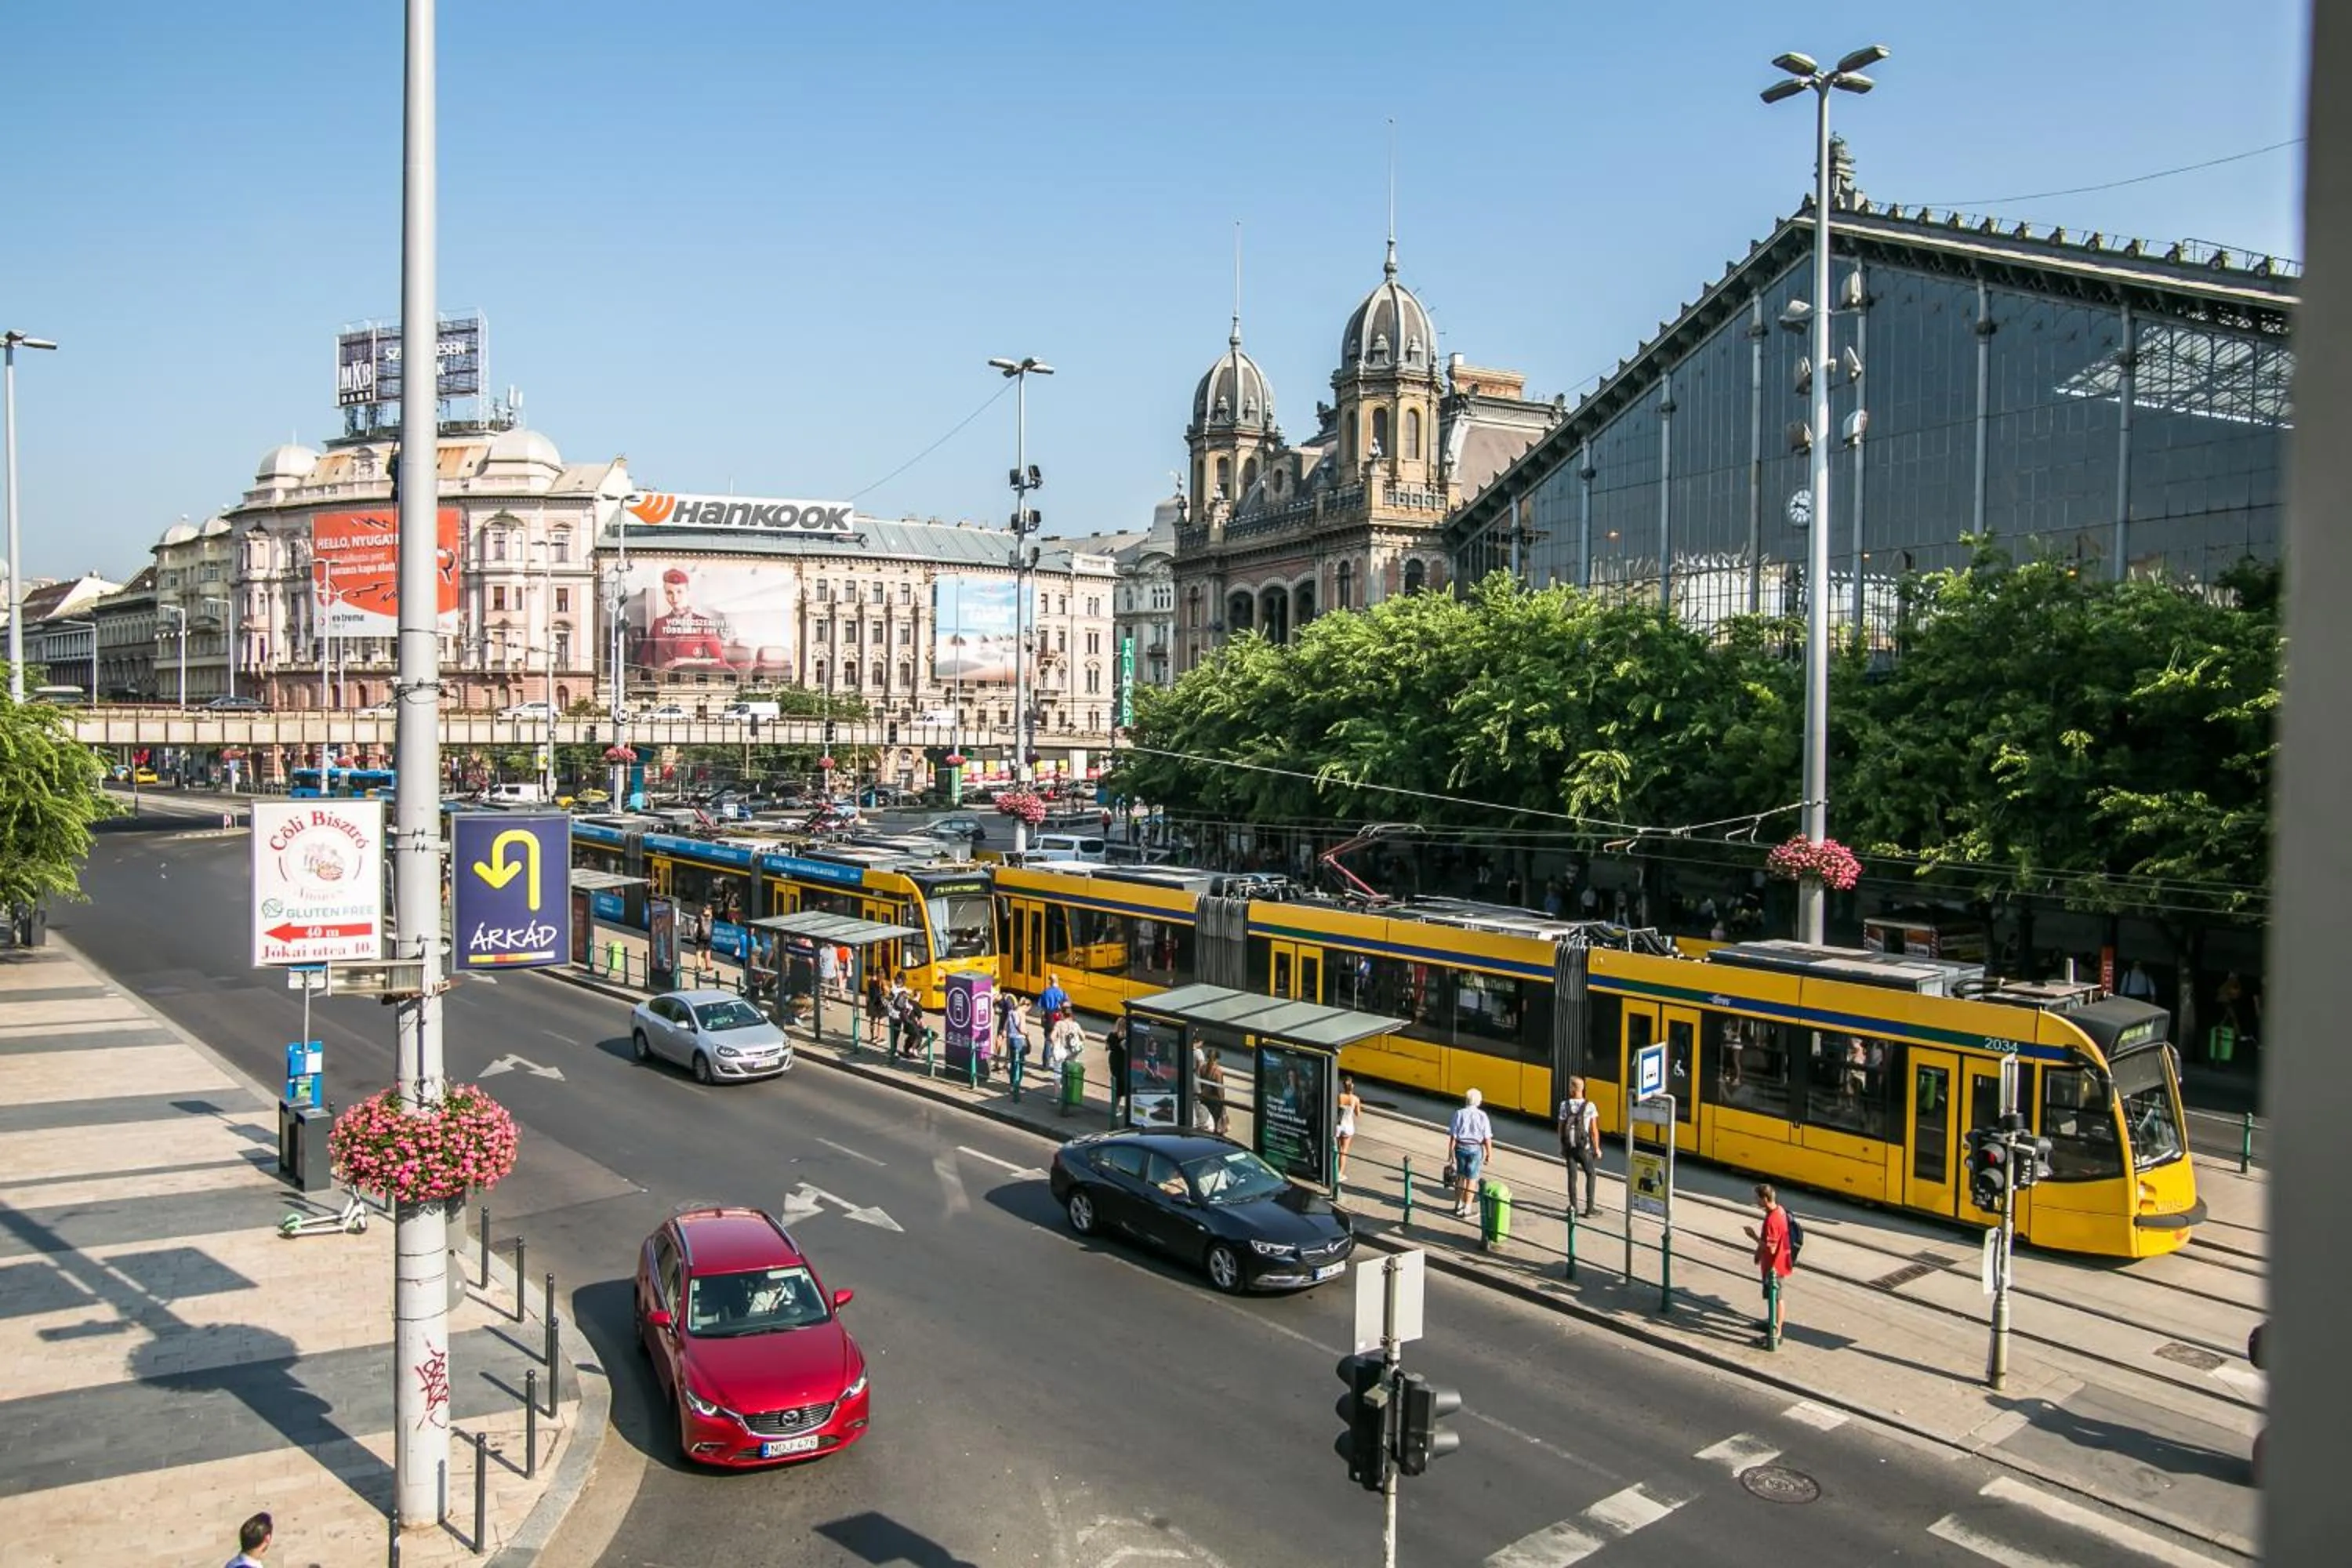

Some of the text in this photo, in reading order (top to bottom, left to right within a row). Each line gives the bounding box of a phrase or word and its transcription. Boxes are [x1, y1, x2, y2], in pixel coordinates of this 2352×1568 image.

[340, 360, 372, 391] MKB
[311, 810, 370, 850] Bisztró
[286, 905, 375, 919] GLUTEN FREE
[325, 928, 339, 938] m
[470, 920, 557, 951] ÁRKÁD
[313, 946, 347, 958] utca
[1984, 1037, 2019, 1054] 2034
